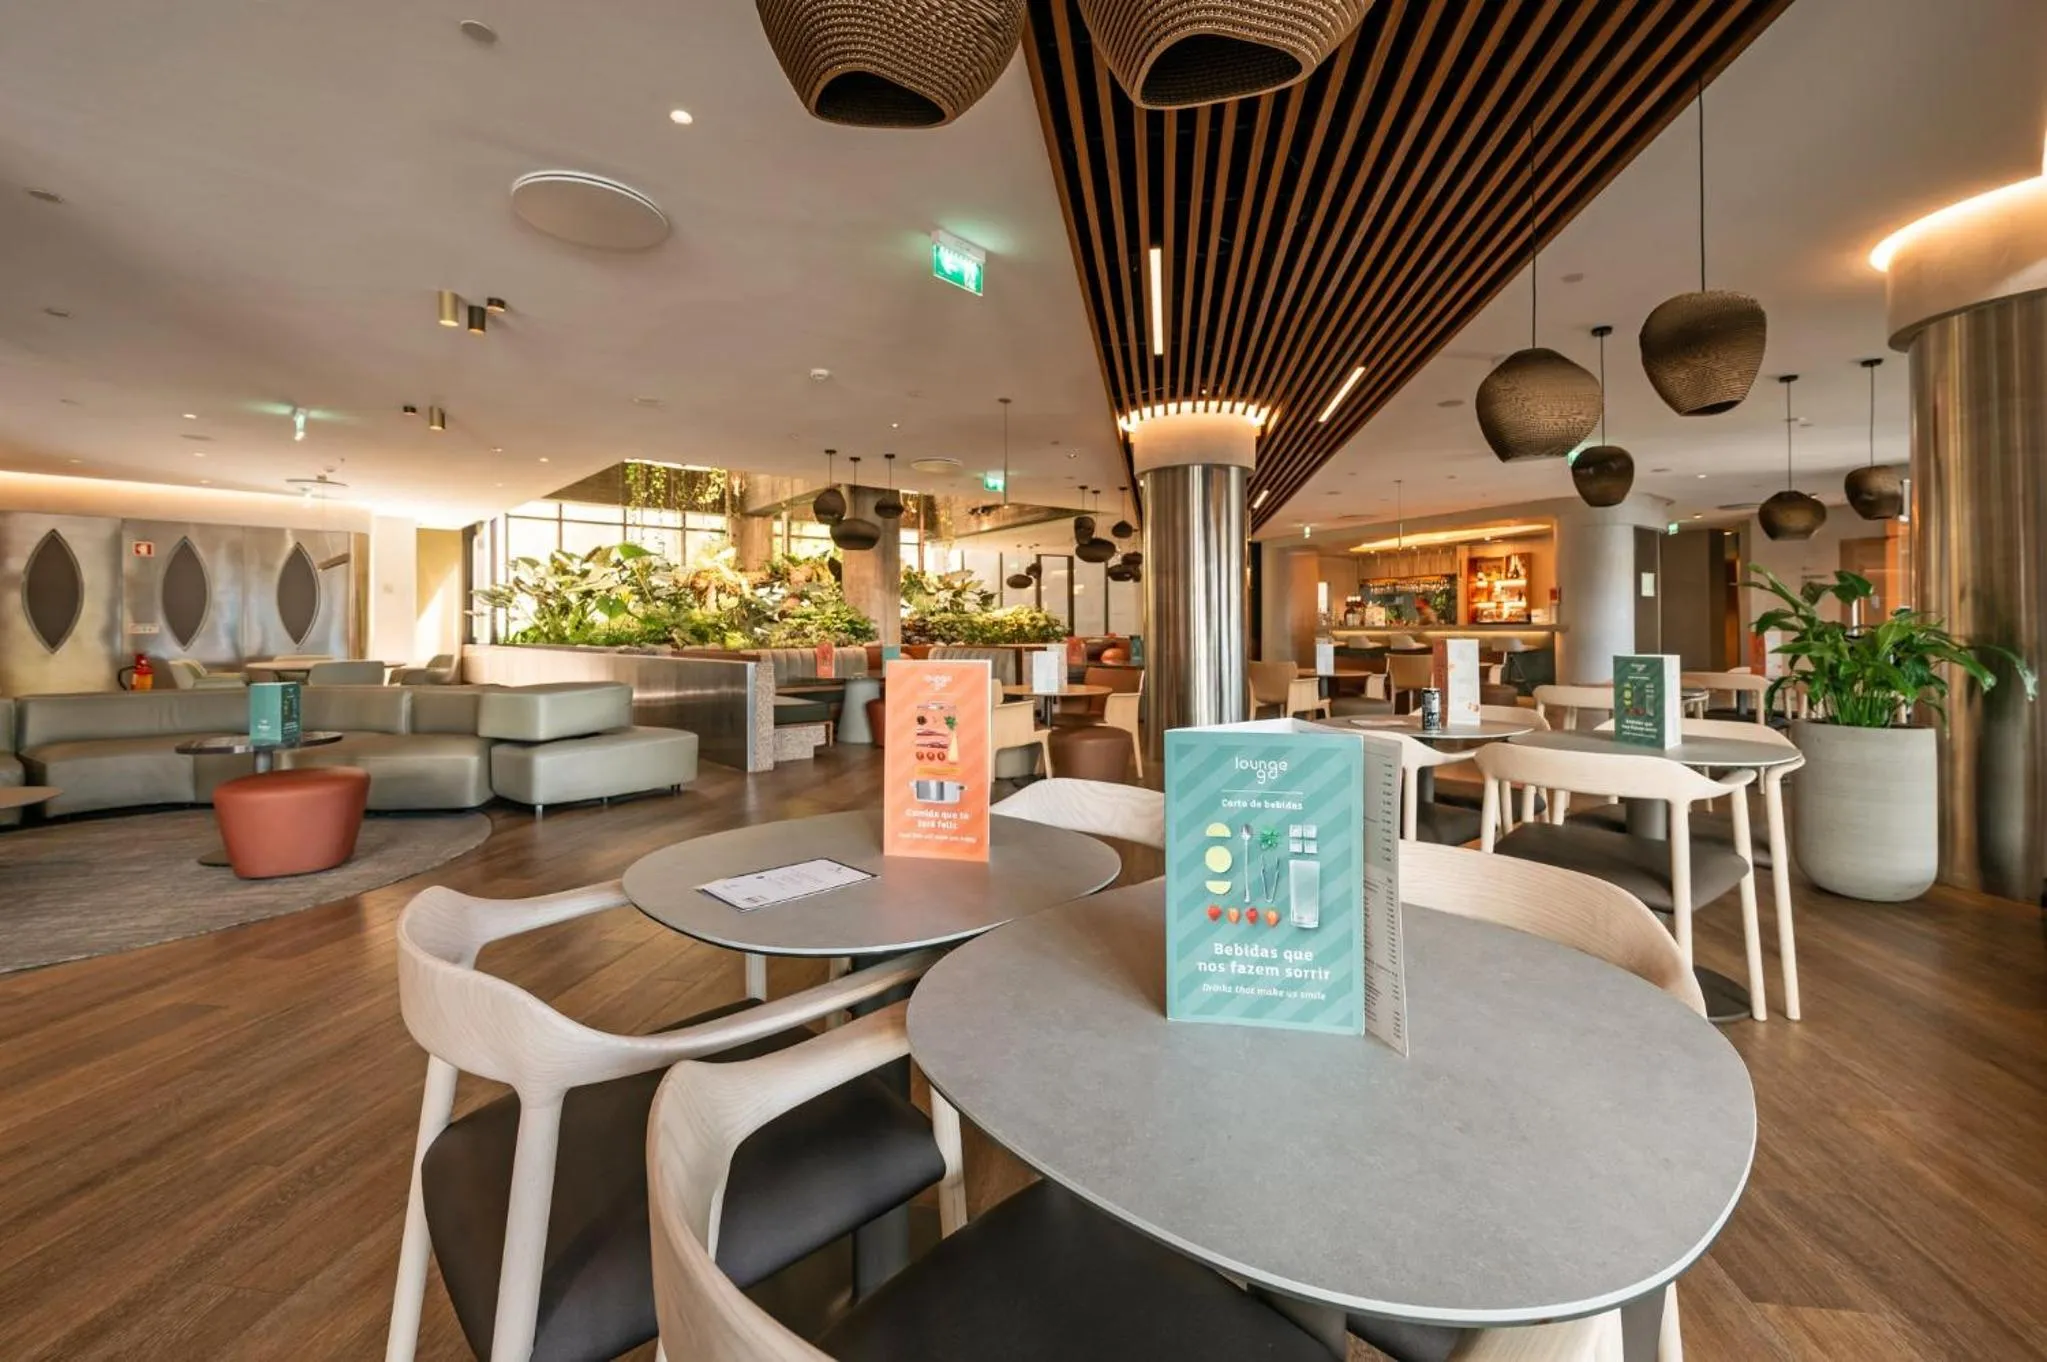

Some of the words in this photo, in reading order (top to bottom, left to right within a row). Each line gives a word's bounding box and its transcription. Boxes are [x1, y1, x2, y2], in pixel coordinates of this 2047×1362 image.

[1235, 756, 1288, 772] lounge
[1264, 799, 1303, 811] bebidas
[1213, 942, 1279, 960] Bebidas
[1283, 949, 1314, 964] que
[1197, 960, 1226, 973] nos
[1229, 960, 1280, 977] fazem
[1284, 966, 1331, 981] sorrir
